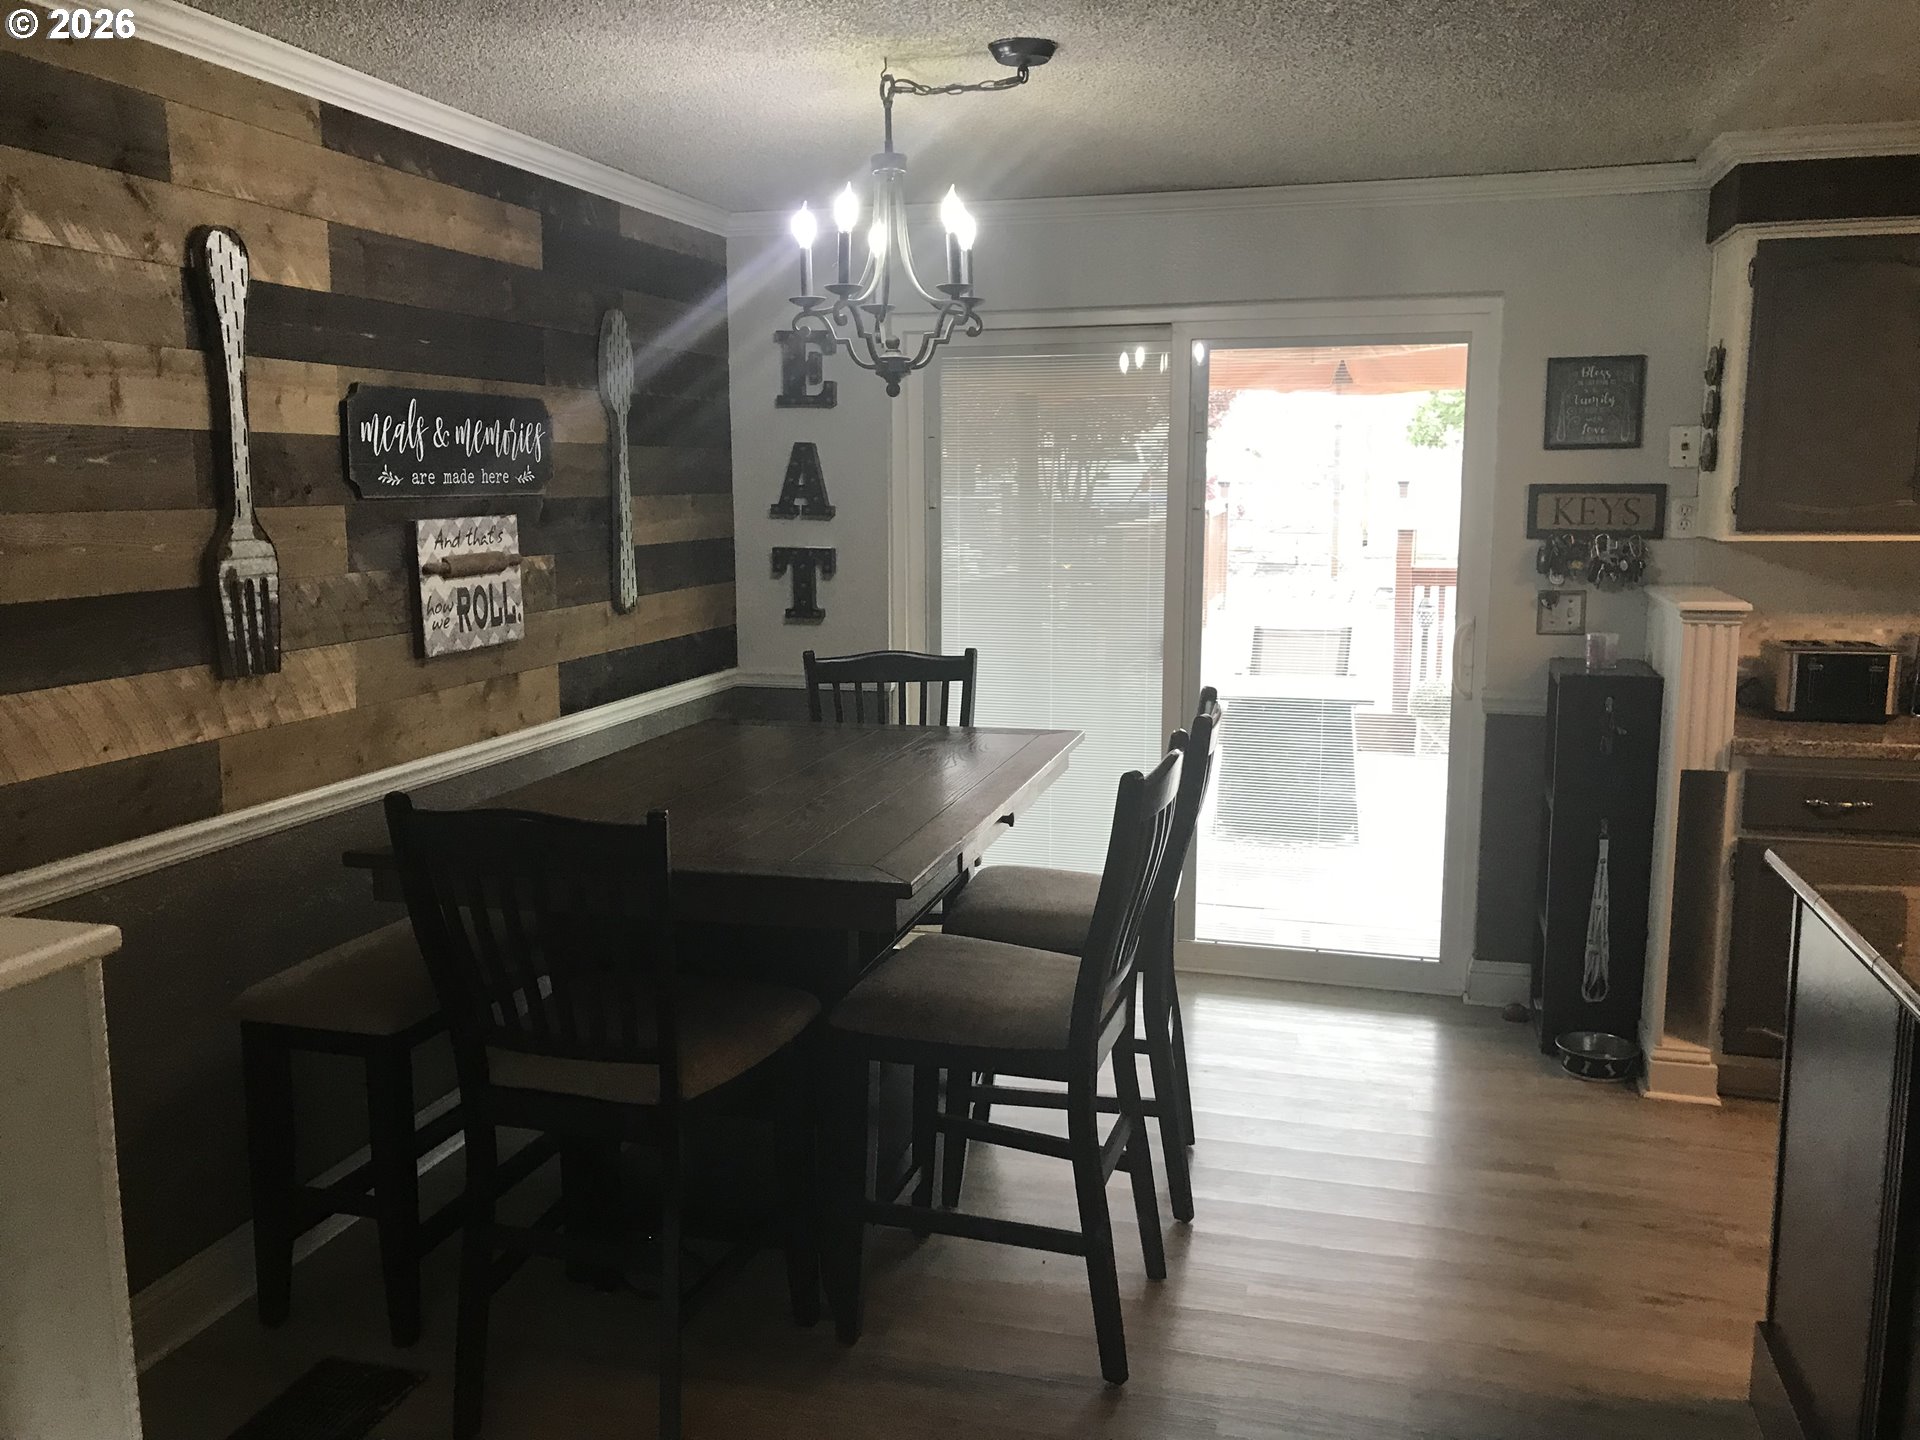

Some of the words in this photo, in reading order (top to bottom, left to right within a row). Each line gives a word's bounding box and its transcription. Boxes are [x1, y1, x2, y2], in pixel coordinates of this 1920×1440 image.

[360, 398, 429, 462] meals
[433, 416, 450, 448] &
[455, 417, 546, 463] memories
[411, 471, 435, 485] are
[443, 468, 475, 485] made
[481, 468, 509, 485] here
[769, 329, 837, 626] EAT
[1552, 496, 1641, 526] KEYS
[434, 528, 461, 550] And
[466, 524, 504, 546] that's
[426, 595, 454, 616] how
[456, 581, 522, 633] ROLL.
[432, 616, 450, 631] we
